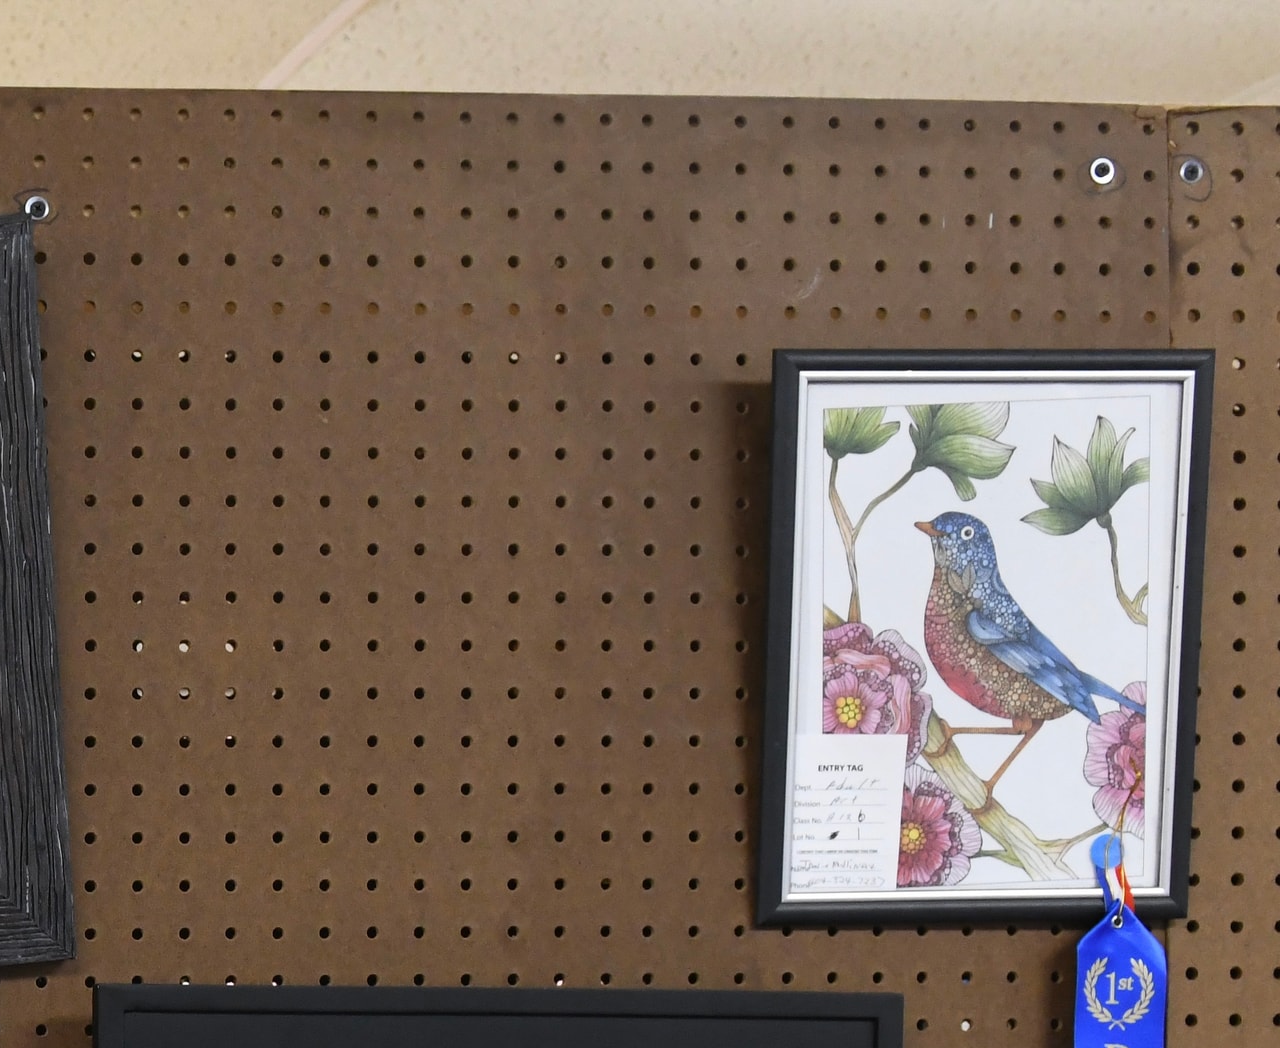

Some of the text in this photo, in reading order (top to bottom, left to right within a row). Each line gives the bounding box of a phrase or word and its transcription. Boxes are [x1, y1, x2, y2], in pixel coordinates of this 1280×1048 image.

[818, 764, 864, 772] ENTRY TAG
[1105, 971, 1134, 1005] 1st
